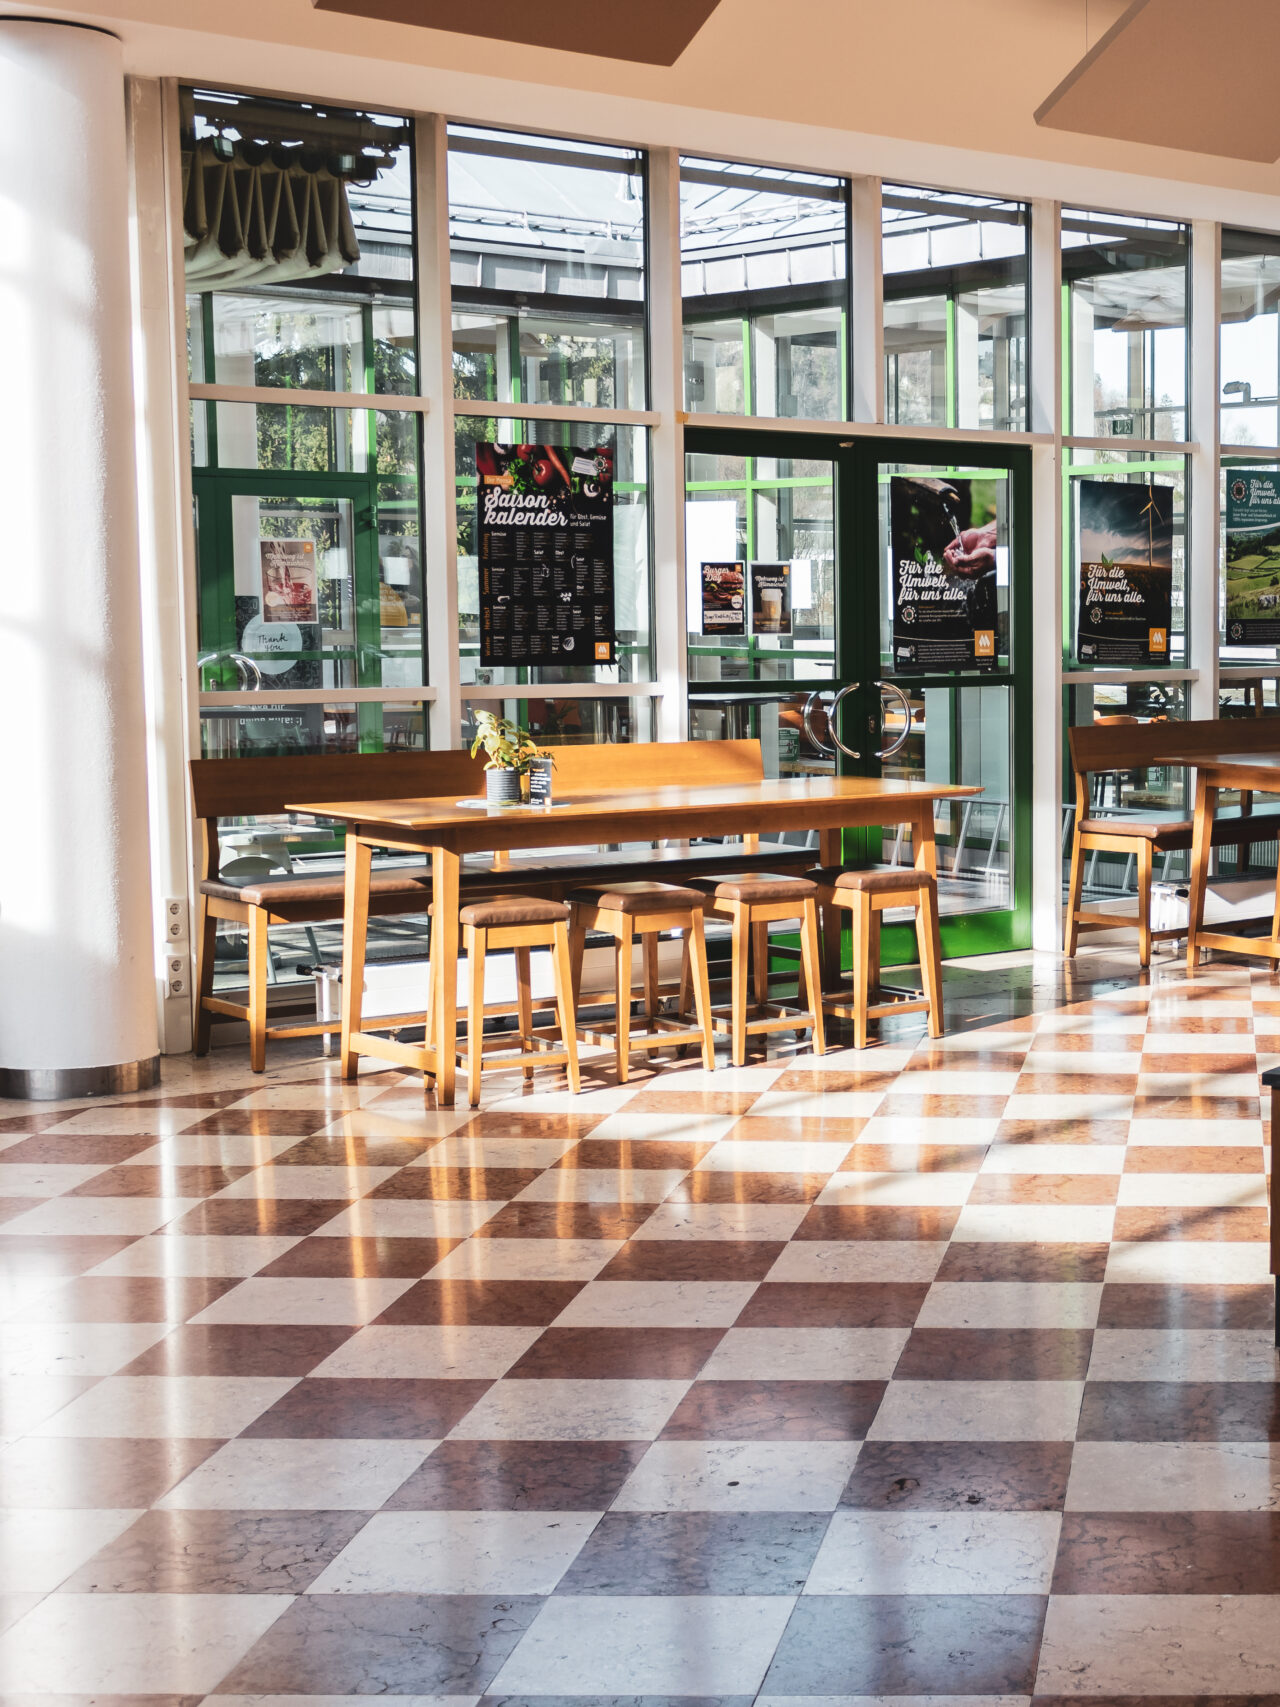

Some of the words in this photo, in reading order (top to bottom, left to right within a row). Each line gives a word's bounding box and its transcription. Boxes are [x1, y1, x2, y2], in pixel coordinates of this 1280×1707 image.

[1249, 479, 1262, 488] Für
[1263, 480, 1274, 488] die
[484, 486, 550, 508] Saison
[1249, 488, 1277, 498] Umwelt,
[1248, 495, 1260, 507] für
[484, 506, 568, 526] kalender
[899, 560, 922, 575] Für
[924, 561, 943, 574] die
[1087, 564, 1108, 578] Für
[1108, 566, 1126, 578] die
[899, 574, 950, 590] Umwelt,
[1087, 577, 1131, 593] Umwelt,
[897, 587, 920, 605] für
[921, 591, 942, 601] uns
[942, 588, 967, 600] alle.
[1085, 589, 1104, 606] für
[1104, 593, 1122, 603] uns
[1123, 591, 1145, 603] alle.
[258, 633, 288, 644] Thank
